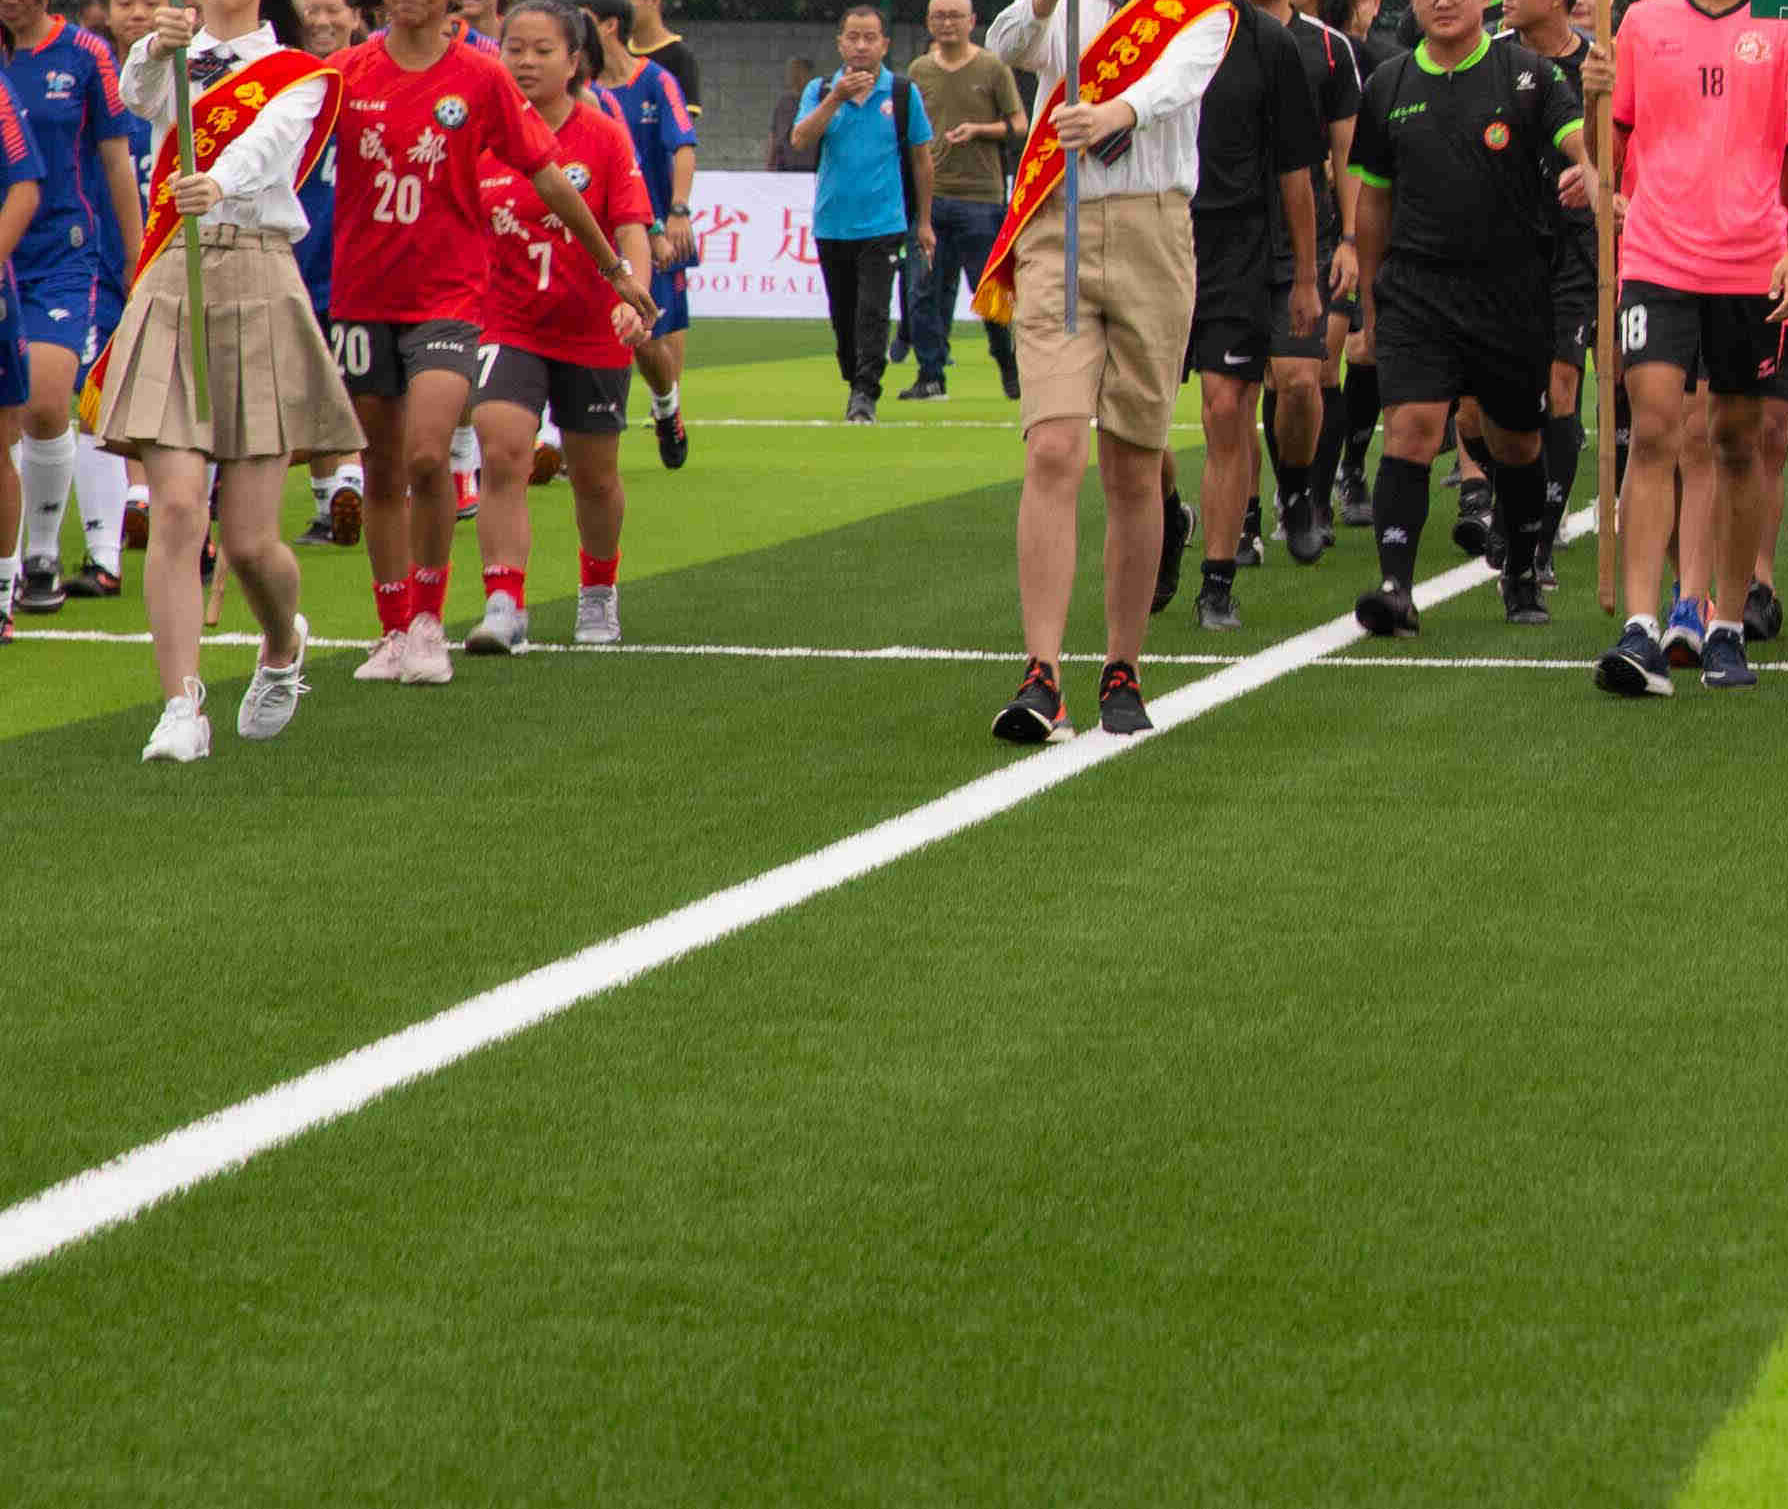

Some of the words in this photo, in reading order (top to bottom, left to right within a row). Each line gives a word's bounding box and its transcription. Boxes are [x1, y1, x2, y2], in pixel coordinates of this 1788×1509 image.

[1698, 67, 1725, 97] 18
[373, 171, 421, 224] 20
[528, 242, 552, 291] 7
